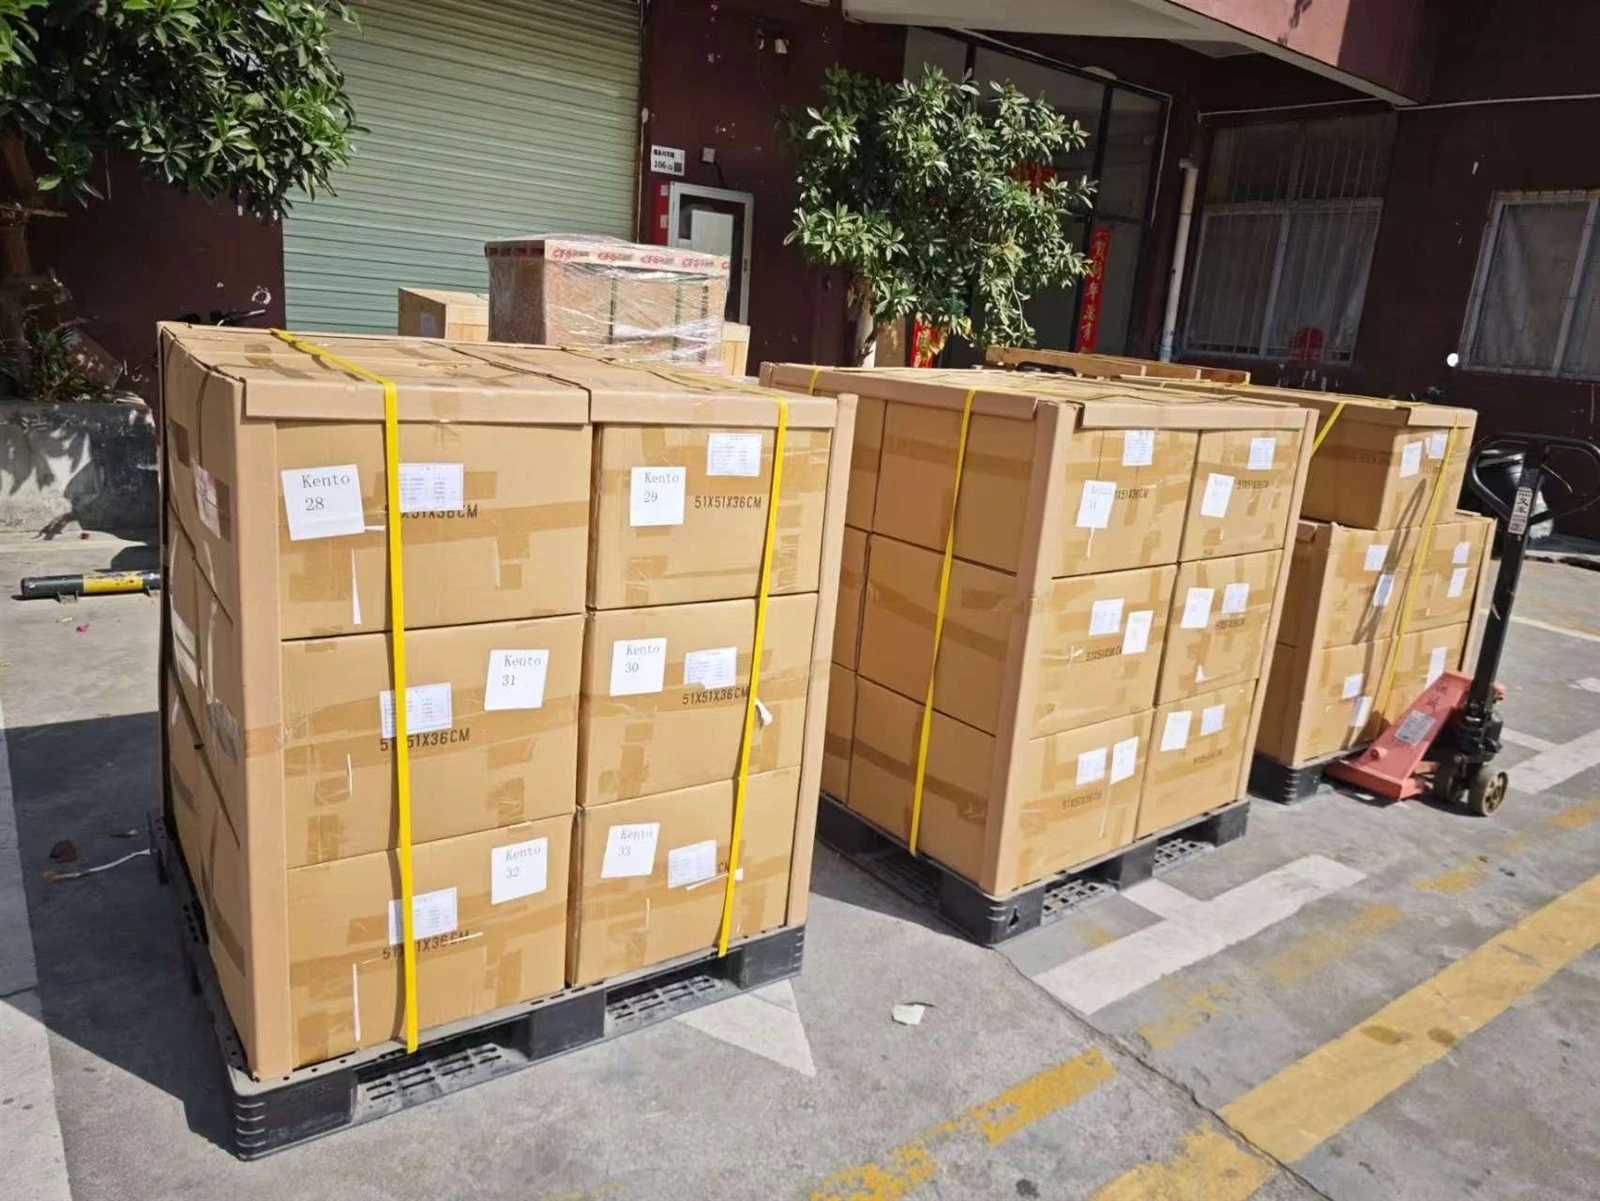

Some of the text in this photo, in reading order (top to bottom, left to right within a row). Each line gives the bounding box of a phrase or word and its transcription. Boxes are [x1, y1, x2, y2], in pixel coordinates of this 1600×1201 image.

[302, 473, 350, 489] Kento
[644, 471, 680, 485] Kento
[304, 496, 325, 512] 28
[643, 490, 658, 504] 29
[694, 495, 762, 510] 51X51X36CM
[626, 643, 660, 656] Kento
[503, 653, 542, 668] Kento
[624, 662, 639, 674] 30
[502, 674, 517, 687] 31
[682, 686, 750, 706] 51X51X36CM
[380, 728, 470, 752] 551X36CM
[505, 845, 542, 862] Kento
[505, 866, 521, 880] 32
